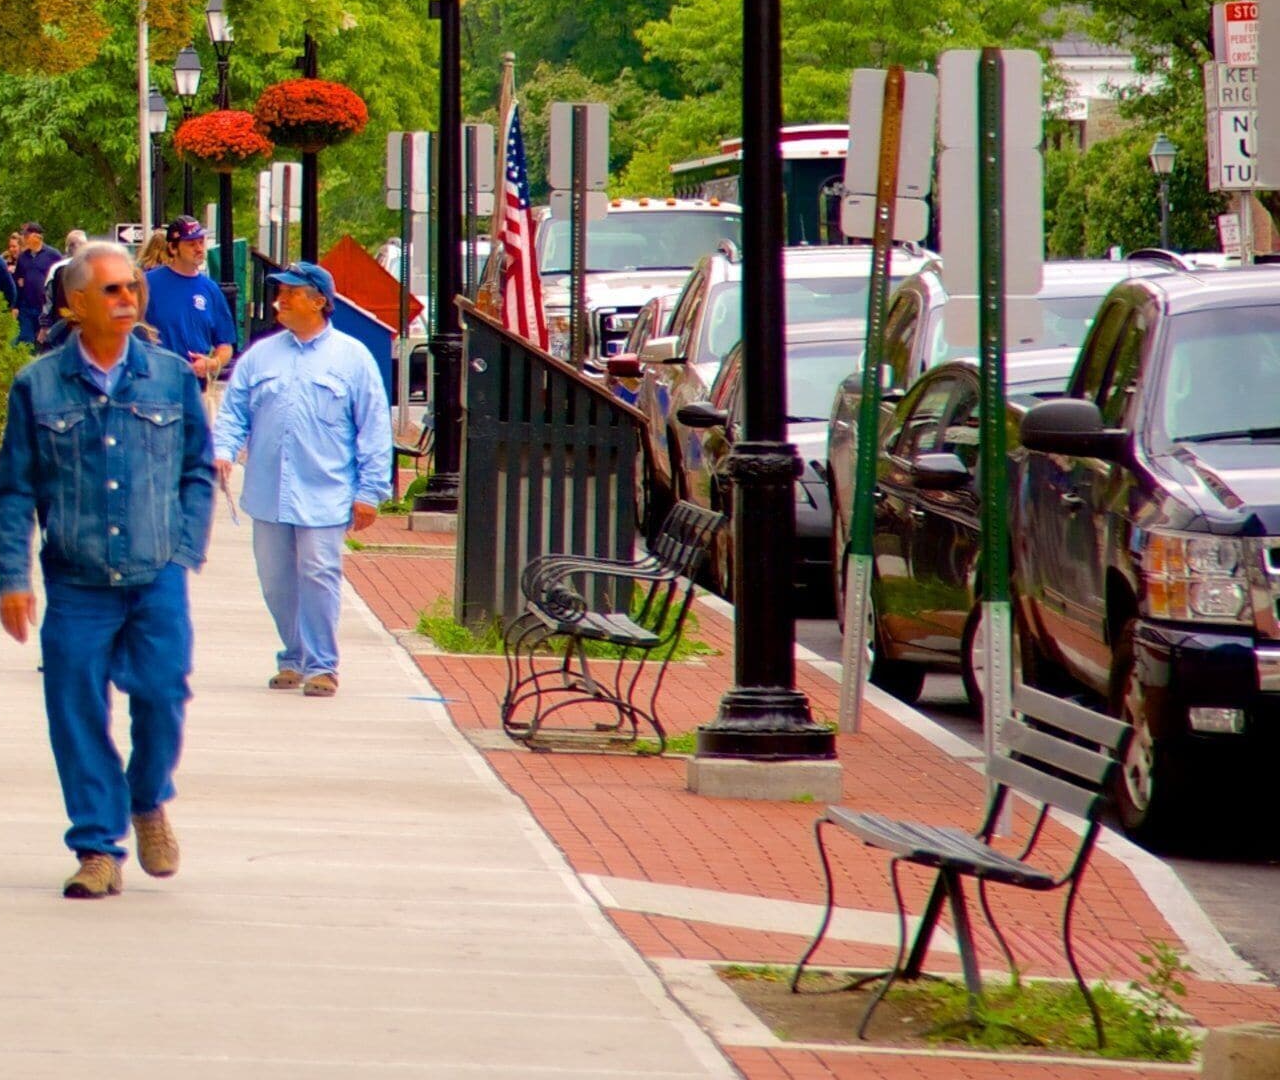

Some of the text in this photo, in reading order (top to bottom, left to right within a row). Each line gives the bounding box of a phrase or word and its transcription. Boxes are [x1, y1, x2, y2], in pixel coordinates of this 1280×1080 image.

[1233, 5, 1258, 19] STO
[1226, 68, 1259, 82] KEE
[1223, 87, 1258, 102] RIG
[1224, 165, 1258, 182] TU
